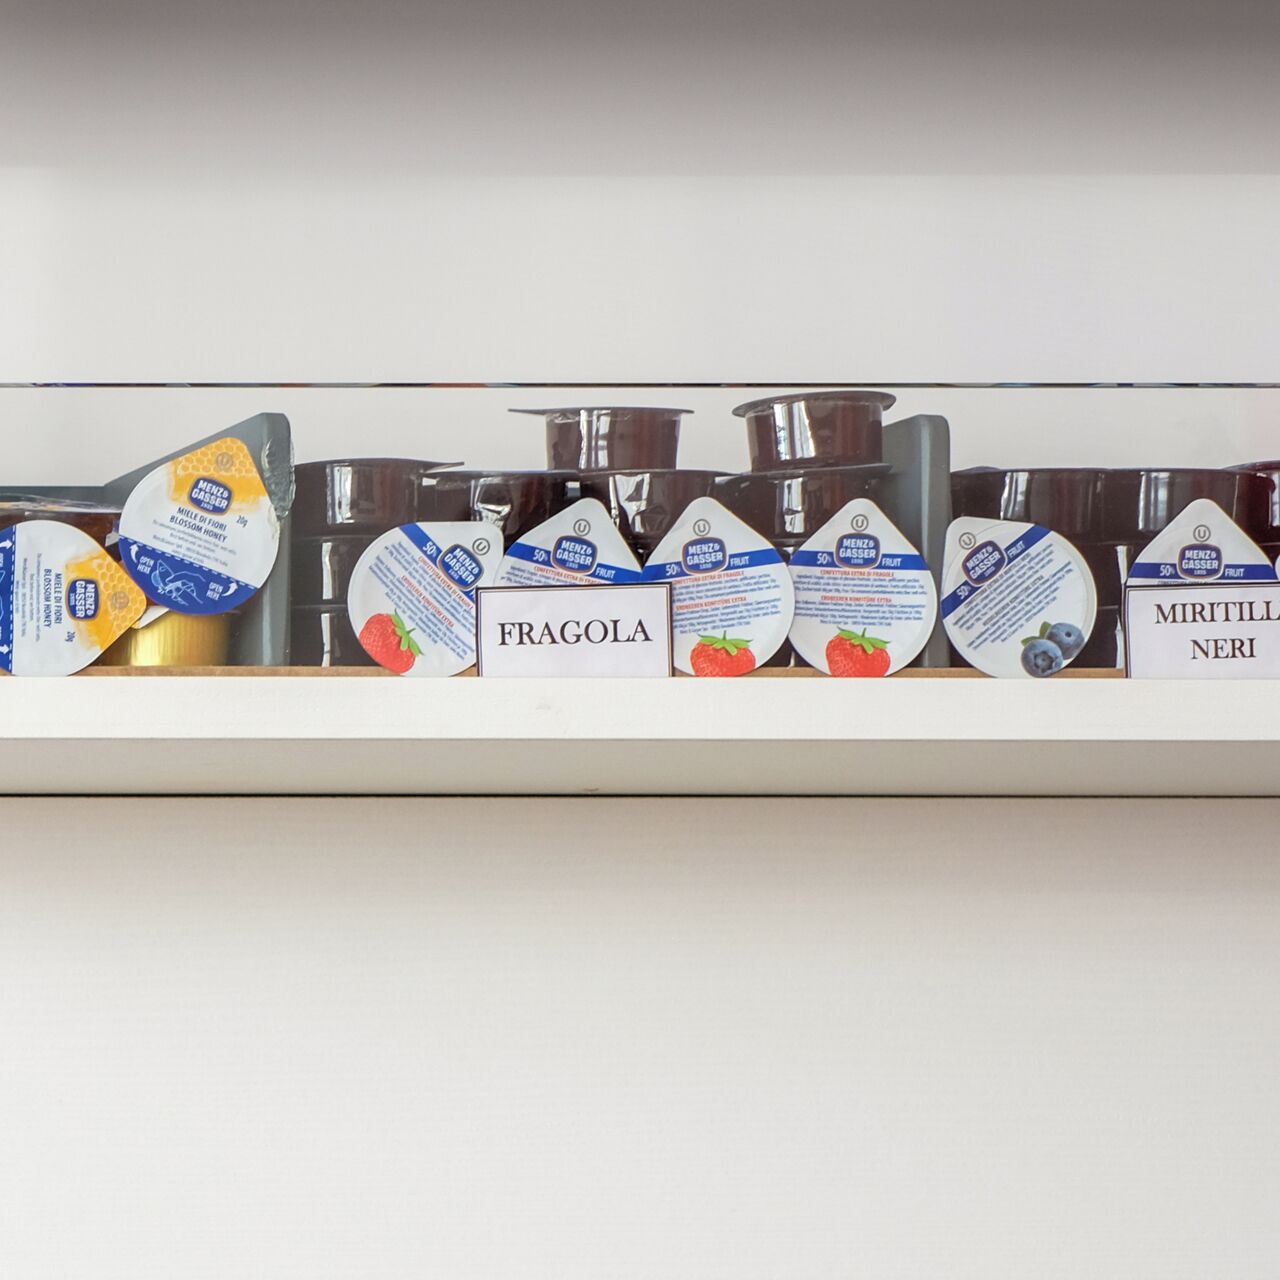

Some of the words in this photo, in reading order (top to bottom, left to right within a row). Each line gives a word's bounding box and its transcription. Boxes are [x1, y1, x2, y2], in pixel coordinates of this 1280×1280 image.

[197, 480, 229, 498] MENZ&
[191, 488, 229, 509] GASSER
[177, 507, 199, 521] MIELE
[207, 517, 227, 531] FIORI
[236, 515, 249, 528] 20g
[169, 516, 203, 534] BLOSSOM
[203, 528, 228, 543] HONEY
[560, 539, 592, 556] MENZ&
[687, 541, 720, 555] MENZ&
[842, 538, 874, 548] MENZ&
[1005, 539, 1027, 559] FRUIT
[139, 556, 155, 567] OPEN
[452, 546, 480, 577] MENZ&
[555, 548, 593, 566] GASSER
[686, 551, 723, 565] GASSER
[729, 555, 750, 567] FRUIT
[839, 547, 876, 558] GASSER
[881, 557, 901, 566] FRUIT
[964, 543, 995, 570] MENZ&
[1185, 550, 1216, 559] MENZ&
[137, 564, 152, 575] HERE
[442, 550, 476, 586] GASSER
[594, 565, 615, 579] FRUIT
[967, 550, 1002, 579] GASSER
[1181, 559, 1218, 569] GASSER
[1224, 568, 1244, 577] FRUIT
[43, 568, 52, 606] BLOSSOM
[53, 572, 62, 593] MIELE
[209, 582, 224, 593] OPEN
[75, 581, 85, 618] GASSER
[43, 606, 51, 628] HONEY
[53, 604, 62, 624] FIORI
[65, 631, 76, 643] 20g
[497, 618, 653, 646] FRAGOLA
[1190, 637, 1257, 660] NERI
